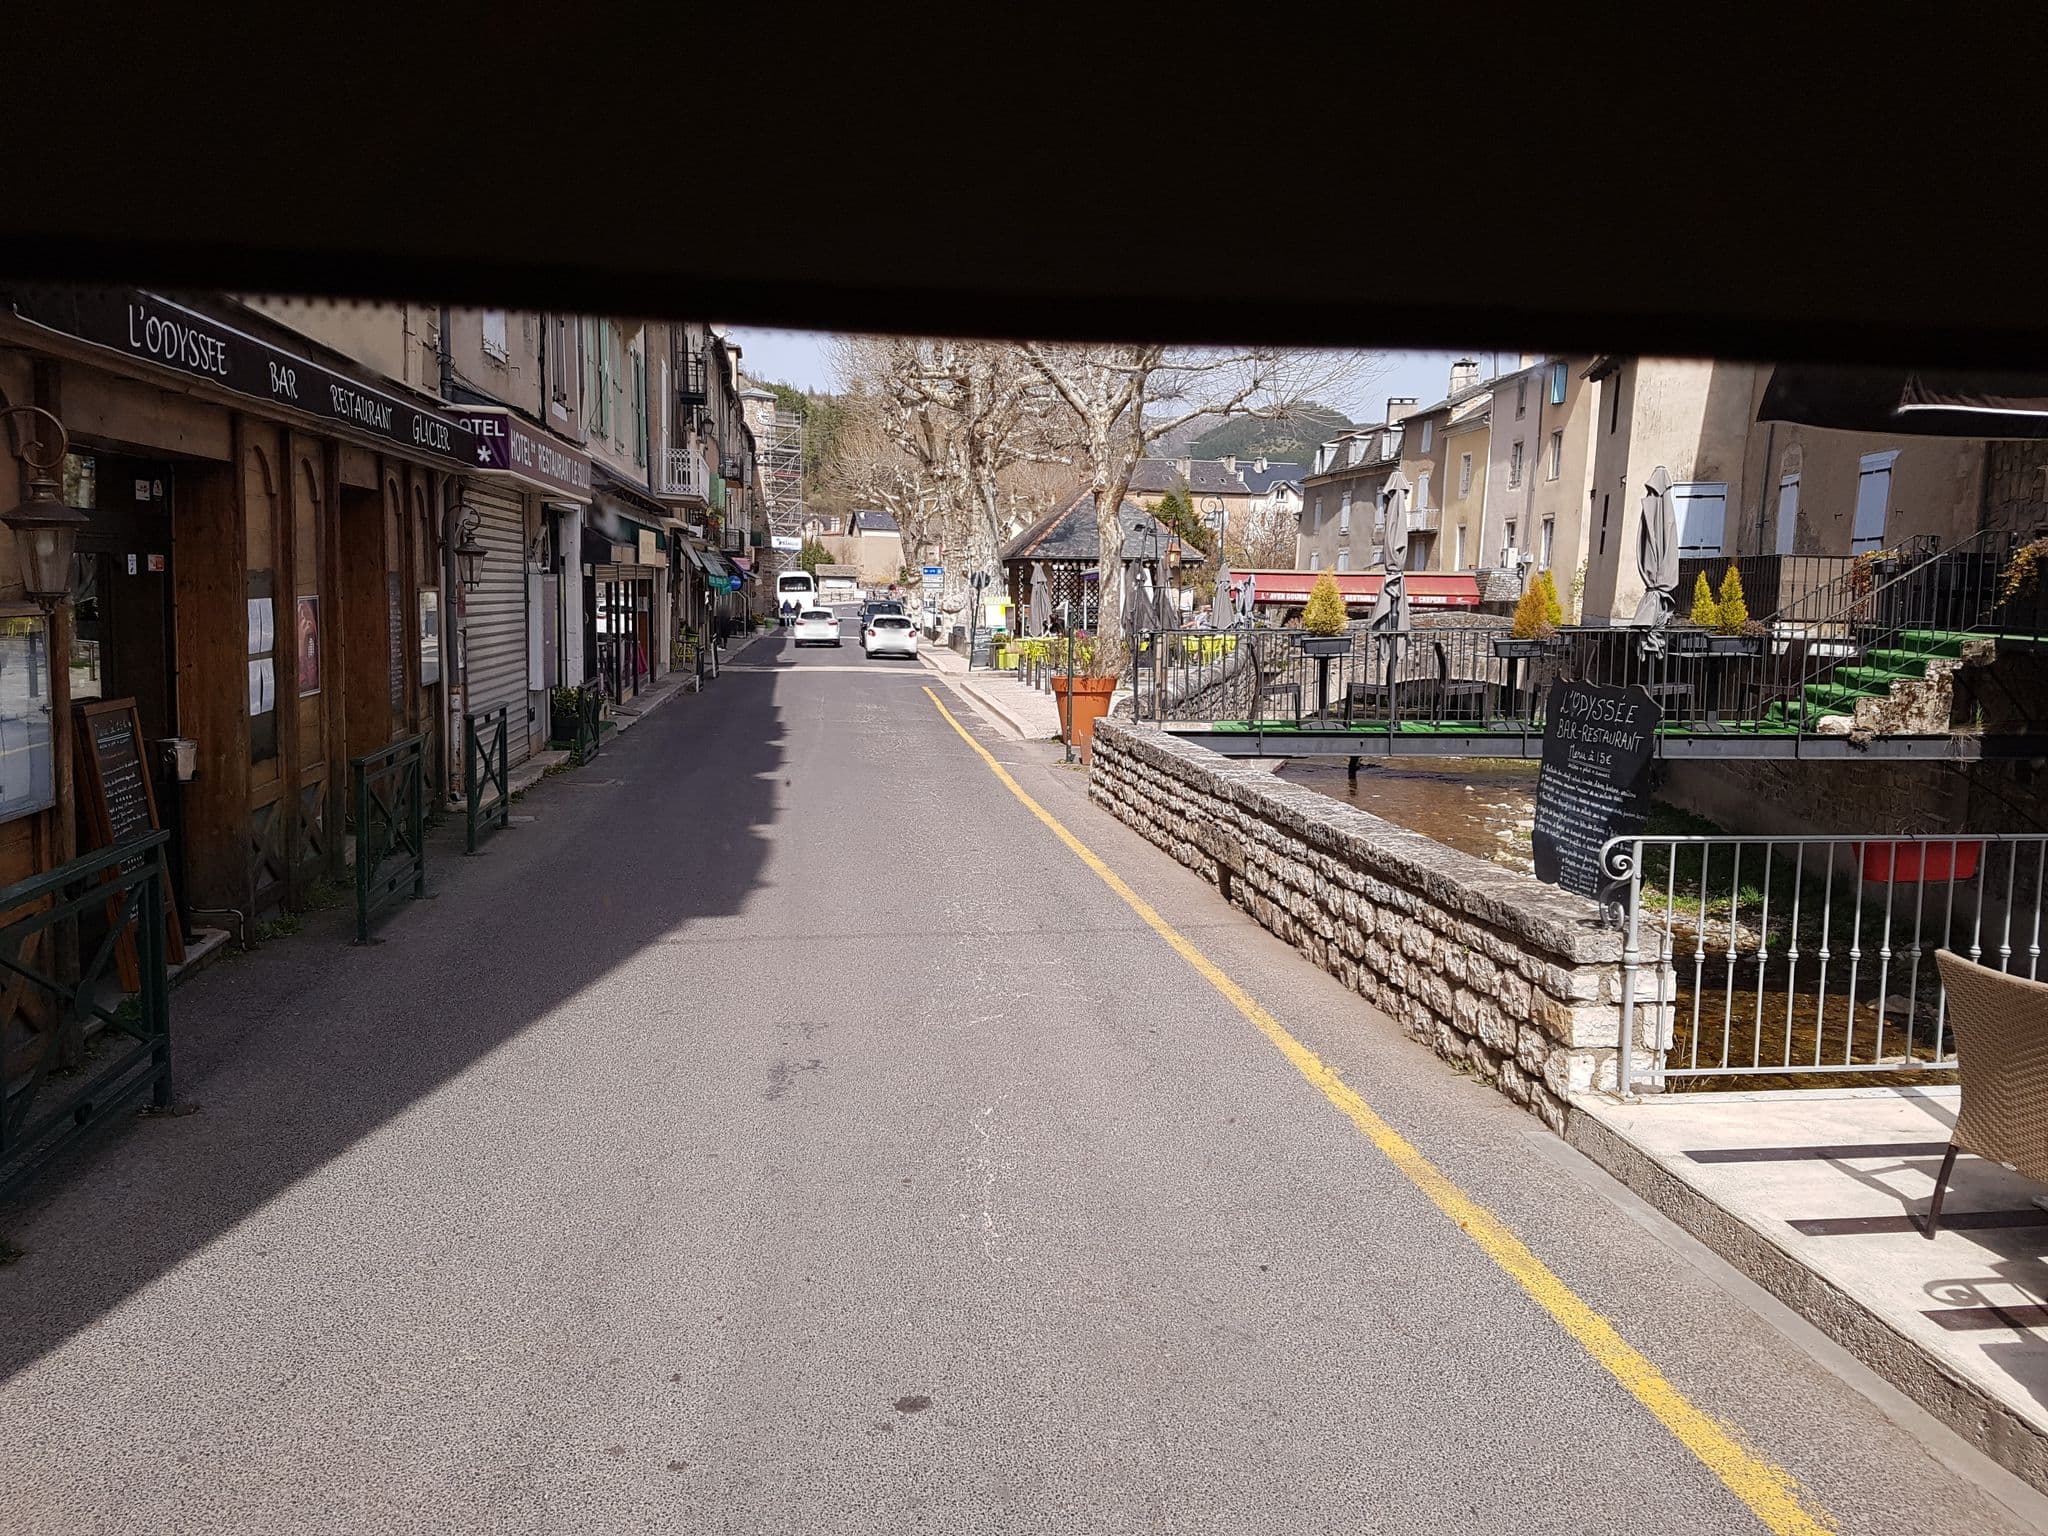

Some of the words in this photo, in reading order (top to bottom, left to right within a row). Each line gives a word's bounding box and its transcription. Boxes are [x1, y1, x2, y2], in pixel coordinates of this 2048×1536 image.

[128, 303, 228, 376] L'ODYSSEE
[268, 360, 298, 400] BAR
[329, 384, 393, 432] RESTAURANT
[412, 414, 451, 453] GLACIER
[459, 418, 505, 438] OTEL
[538, 443, 571, 482] RESTAURANT
[1344, 594, 1378, 603] RESTAURA
[1559, 690, 1639, 724] L'ODYSSÉE
[1556, 718, 1645, 753] BAR-RESTAURANT
[1596, 750, 1613, 765] 15€
